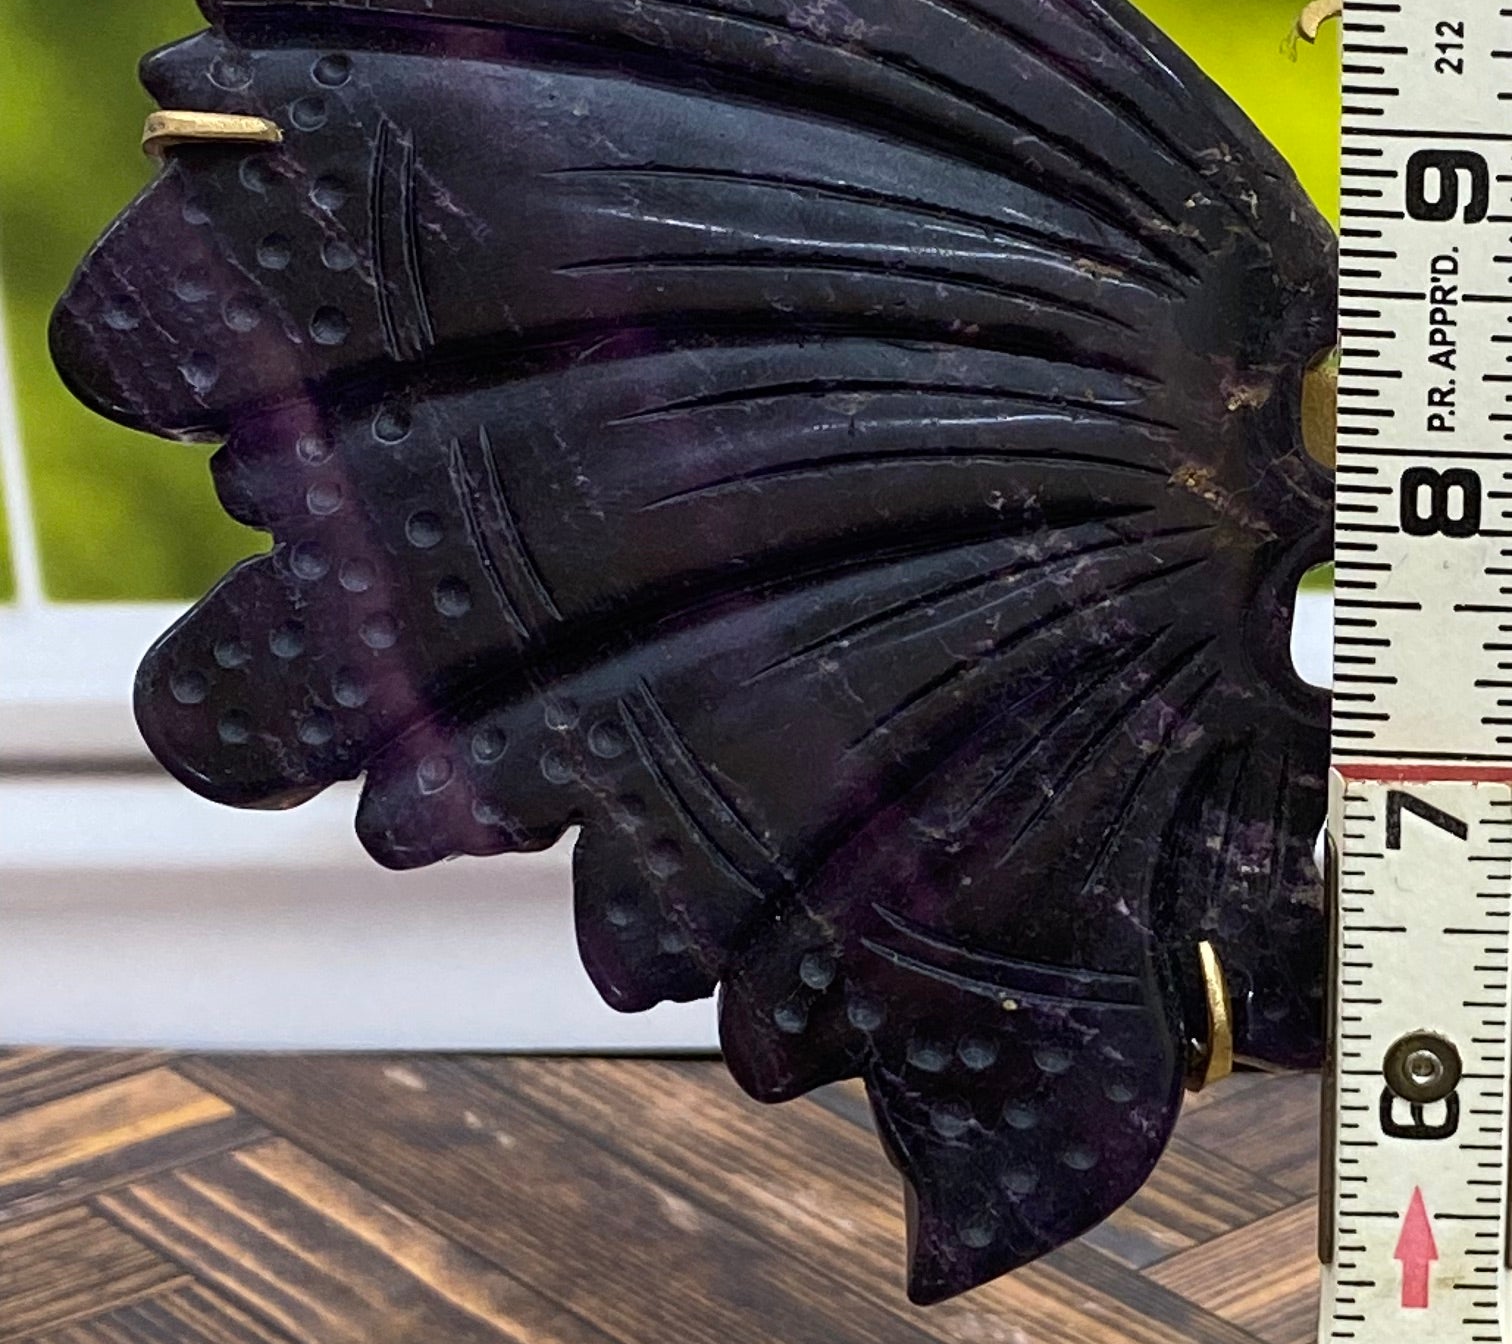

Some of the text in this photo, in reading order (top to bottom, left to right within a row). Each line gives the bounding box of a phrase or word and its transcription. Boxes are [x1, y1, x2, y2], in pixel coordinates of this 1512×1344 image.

[1434, 21, 1464, 75] 212
[1405, 149, 1490, 225] 9
[1428, 246, 1460, 371] APPR'D.
[1400, 466, 1482, 538] 8
[1386, 790, 1469, 850] 7
